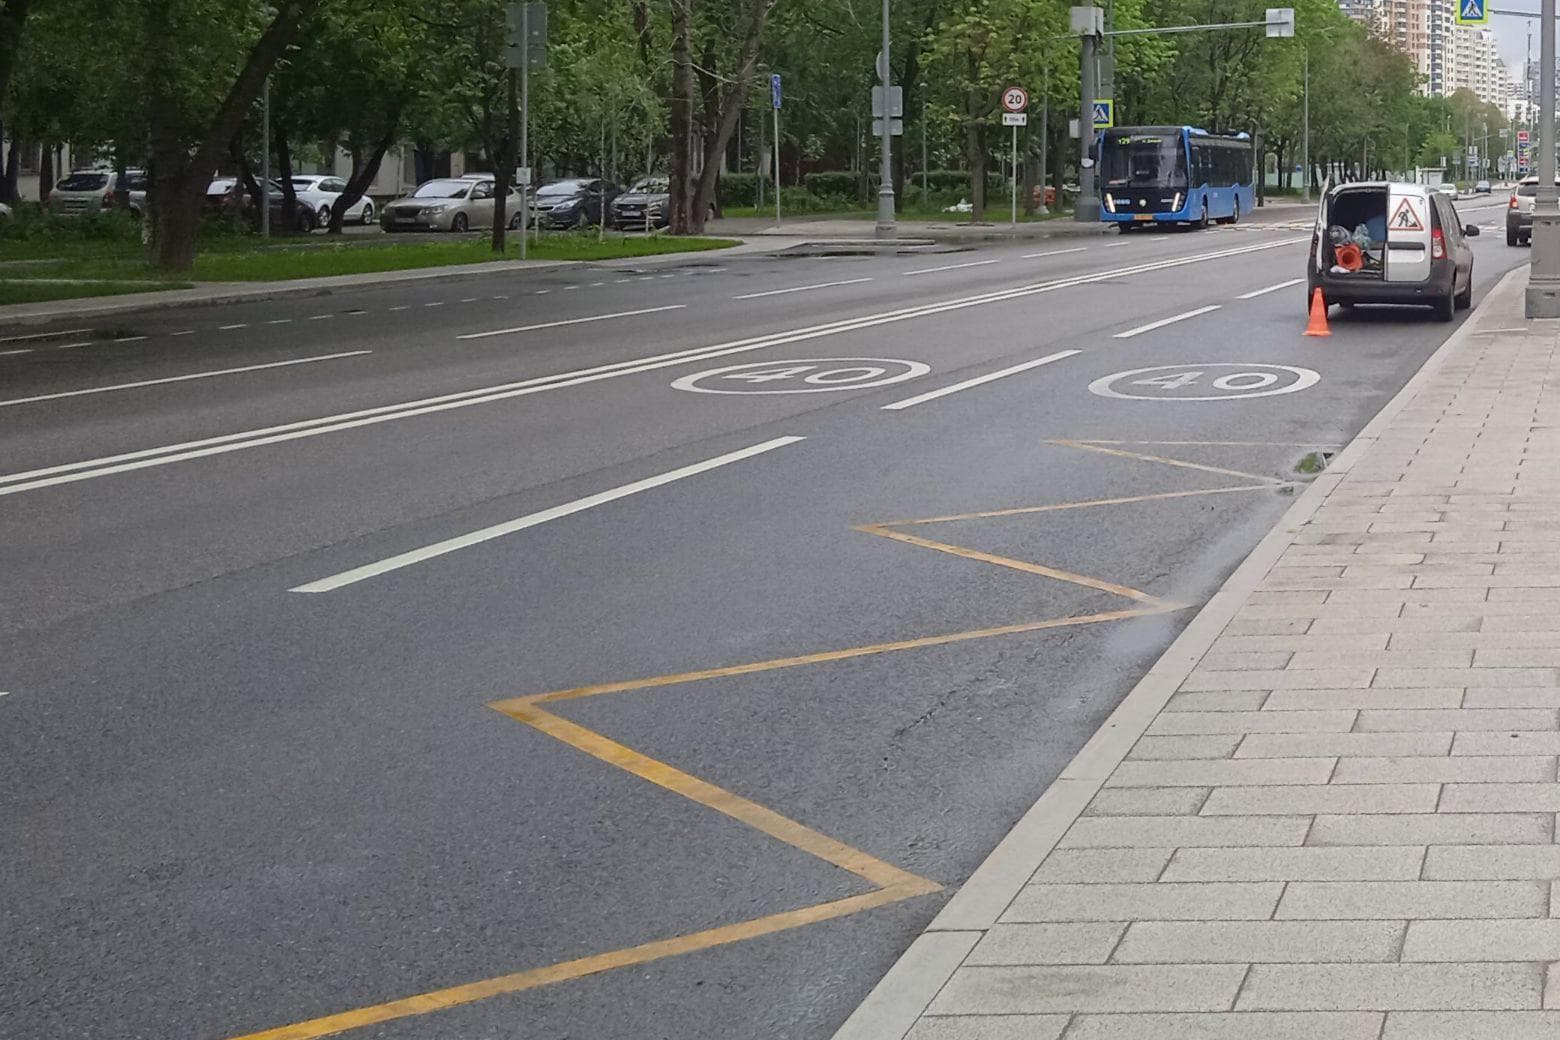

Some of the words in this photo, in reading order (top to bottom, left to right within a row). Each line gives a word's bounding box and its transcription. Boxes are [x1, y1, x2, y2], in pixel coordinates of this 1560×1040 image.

[1008, 94, 1022, 104] 20
[721, 365, 887, 384] 40
[1131, 371, 1279, 390] 40
